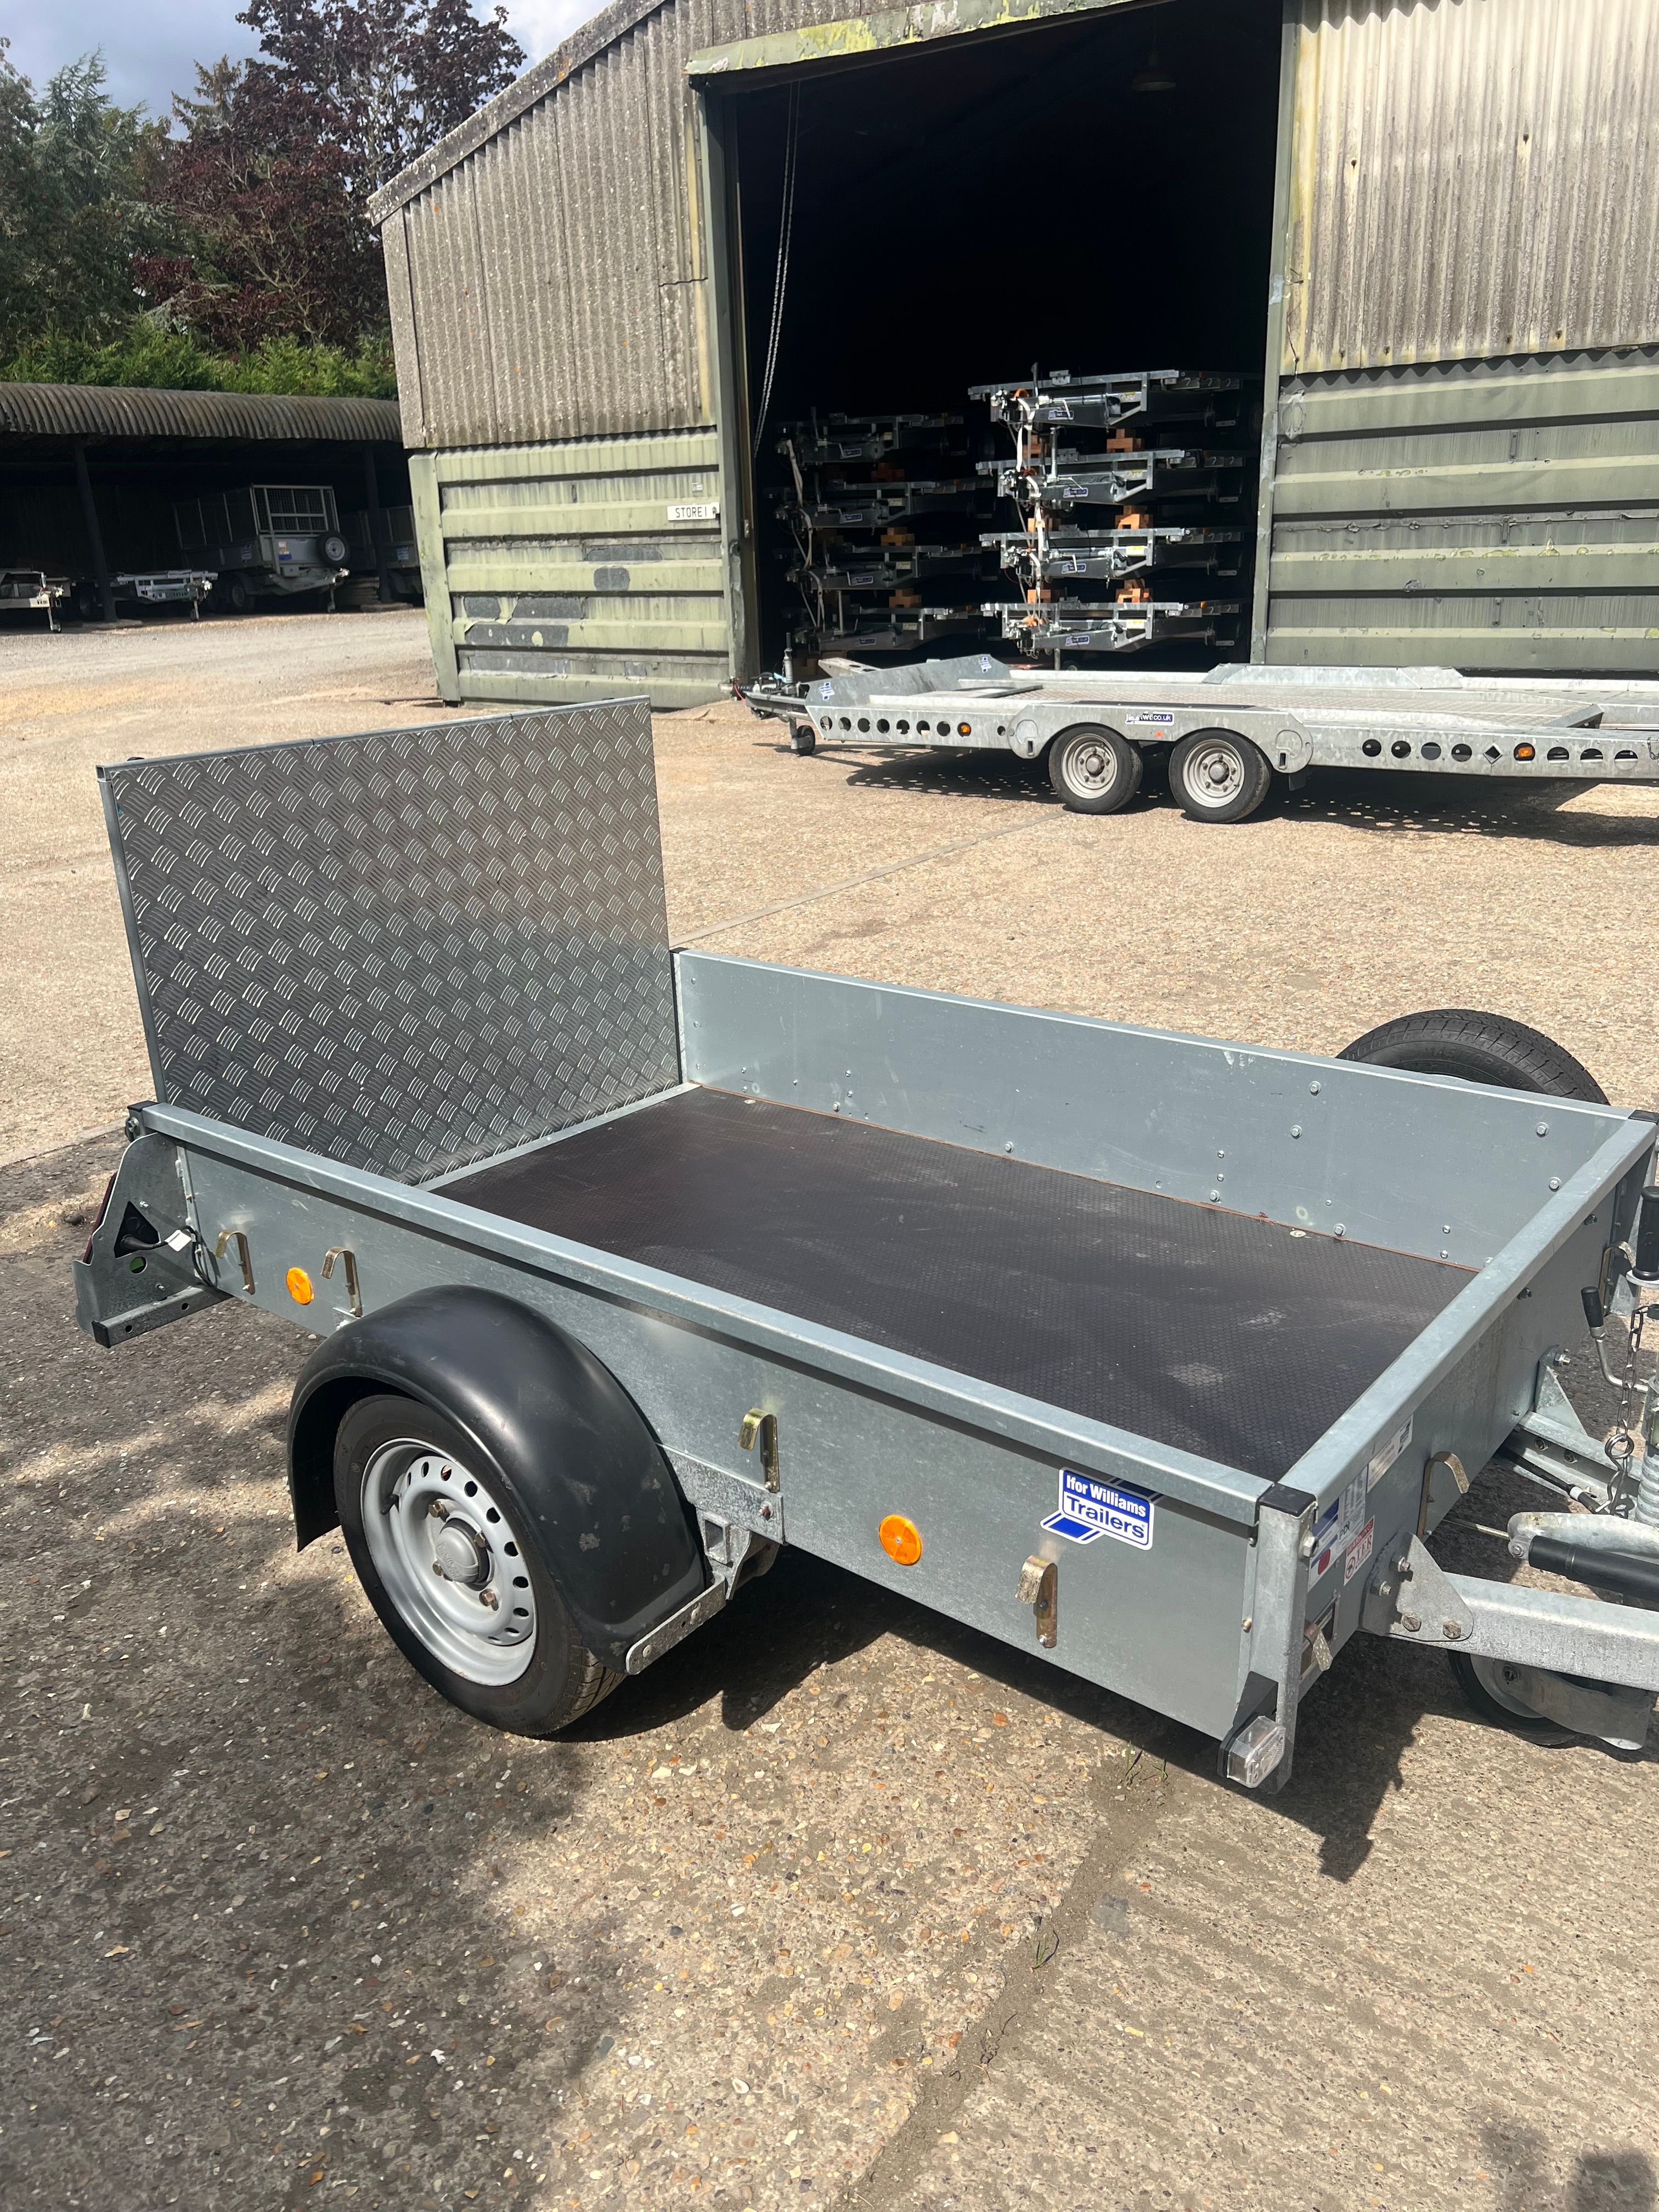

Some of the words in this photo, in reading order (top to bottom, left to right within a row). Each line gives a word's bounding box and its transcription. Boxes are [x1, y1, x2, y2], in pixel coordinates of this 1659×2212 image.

[675, 507, 702, 518] STORE
[1066, 1475, 1088, 1495] Ifor
[1090, 1483, 1146, 1517] Williams
[1066, 1495, 1145, 1538] Trailers
[1339, 1521, 1350, 1539] PDI
[1356, 1534, 1372, 1560] TER
